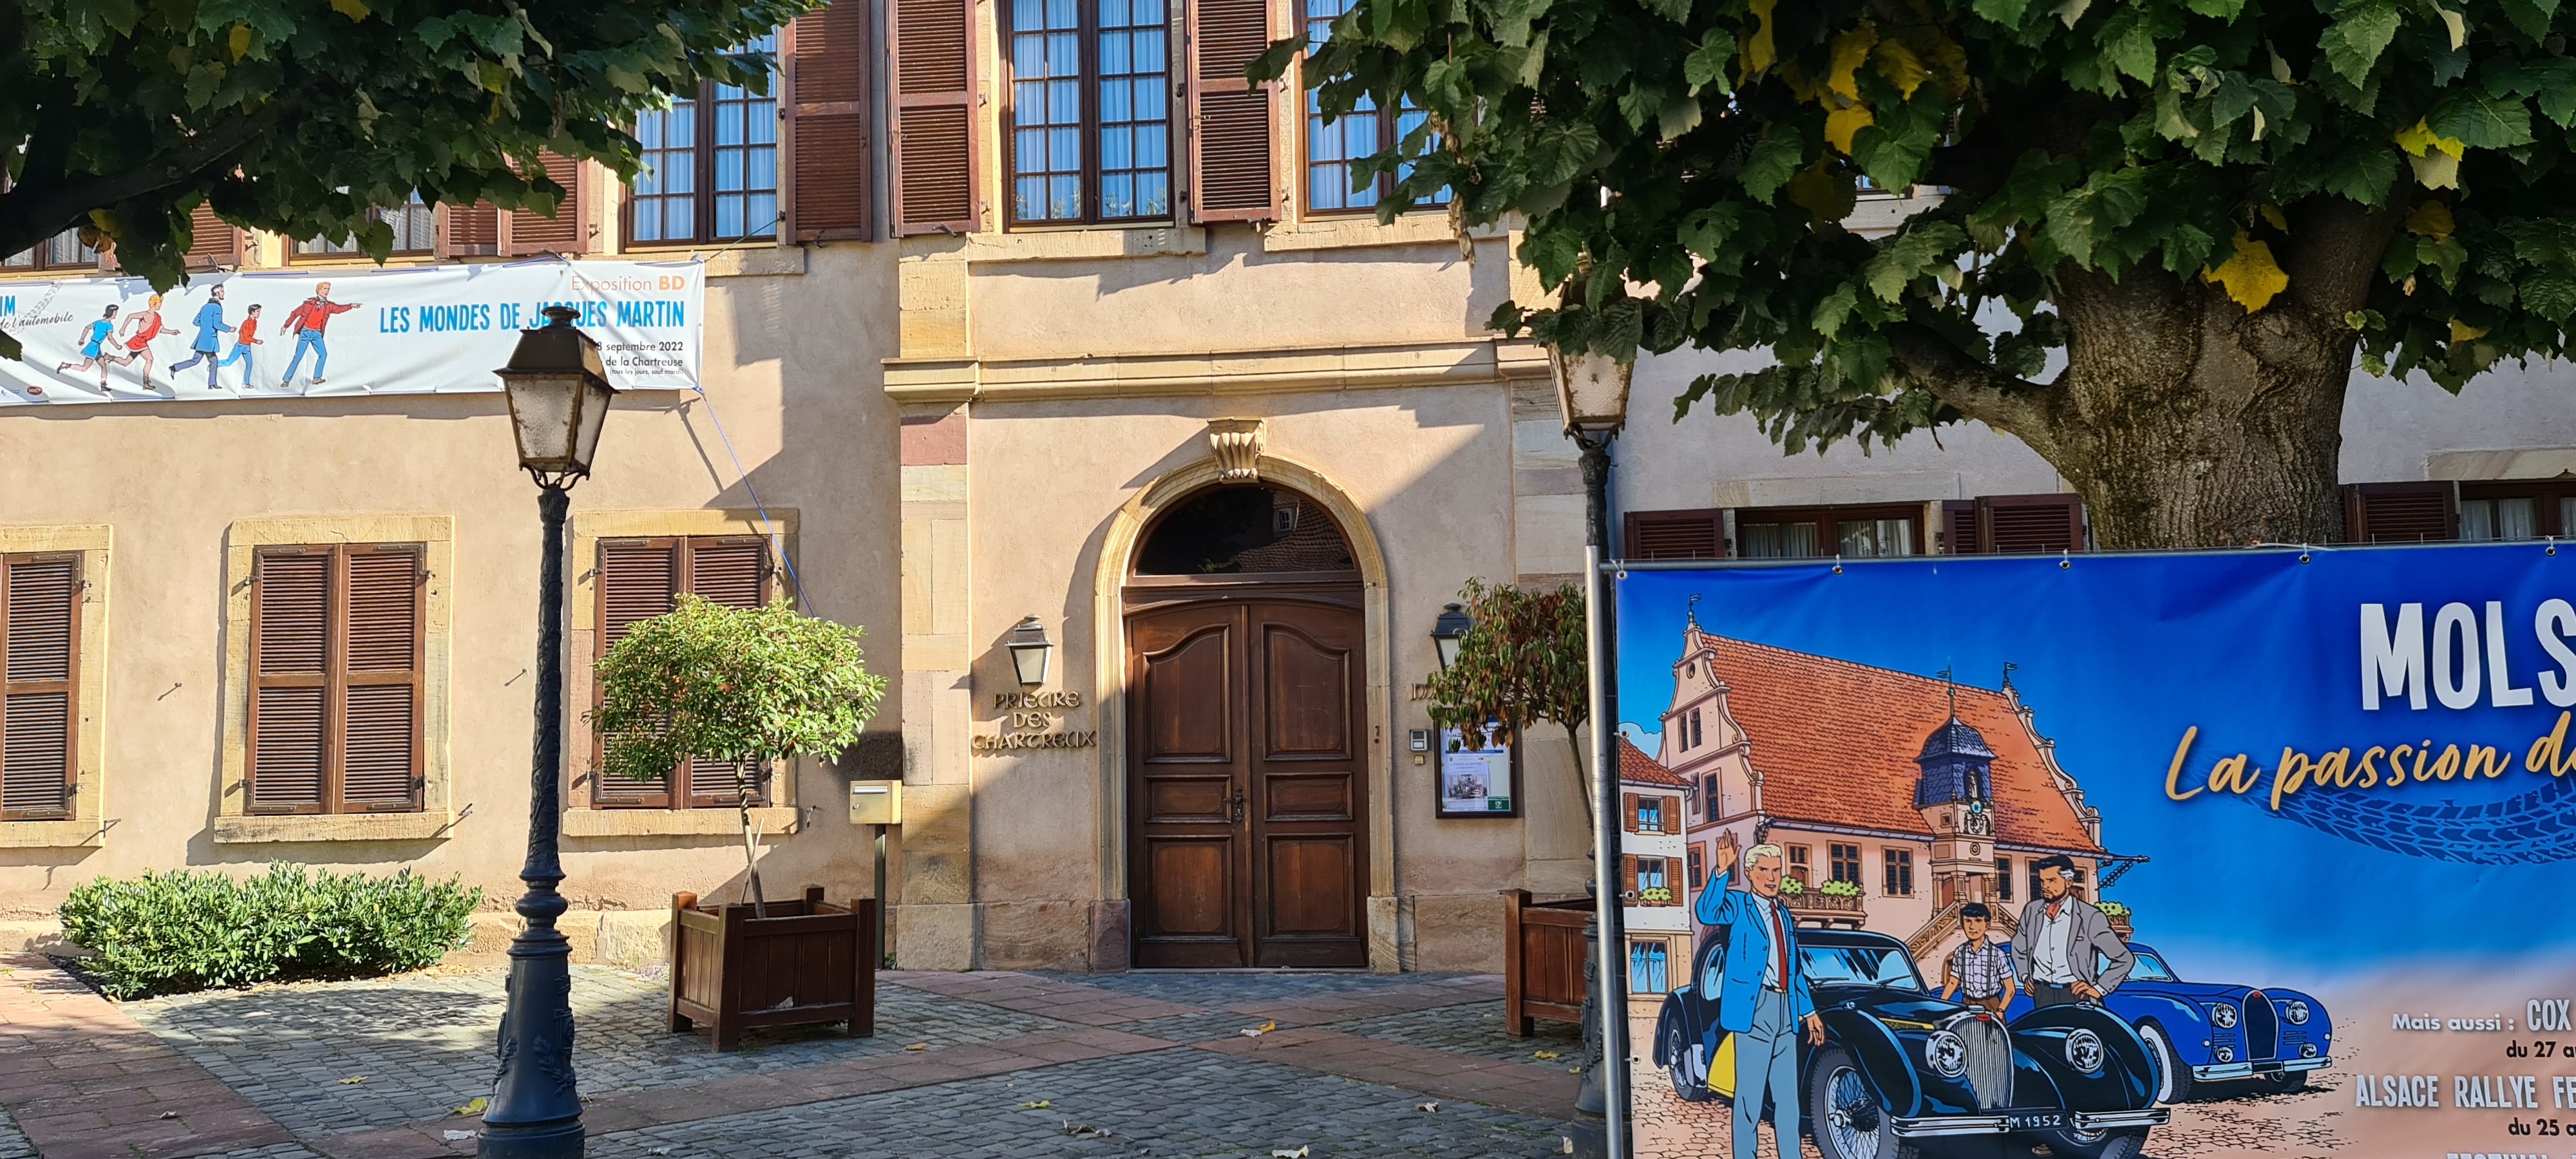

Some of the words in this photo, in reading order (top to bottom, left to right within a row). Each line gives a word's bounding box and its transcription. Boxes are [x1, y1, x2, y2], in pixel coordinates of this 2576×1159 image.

[572, 276, 652, 294] Exposition
[659, 276, 685, 290] BD
[12, 311, 73, 328] l'automobile
[380, 307, 410, 333] LES
[419, 304, 489, 332] MONDES
[500, 303, 520, 330] DE
[529, 301, 607, 328] JAUES
[616, 301, 684, 327] MARTIN
[606, 341, 656, 353] septembre
[659, 341, 683, 351] 2022
[606, 356, 616, 366] de
[621, 356, 629, 366] la
[632, 356, 683, 366] Chartreuse
[2360, 599, 2576, 710] MOLS
[993, 690, 1079, 708] PRIEURE
[1013, 711, 1052, 728] DES
[971, 730, 1096, 749] CHARTREUX
[2164, 726, 2260, 800] La
[2270, 740, 2510, 810] passion
[2525, 710, 2576, 777] d
[2392, 1013, 2441, 1030] Mais
[2447, 1013, 2501, 1030] aussi
[2527, 999, 2572, 1031] COX
[2506, 1039, 2528, 1058] du
[2533, 1041, 2557, 1058] 27
[2562, 1046, 2576, 1058] a
[2355, 1075, 2439, 1107] ALSACE
[2454, 1075, 2539, 1108] RALLYE
[2009, 1117, 2020, 1128] M
[2025, 1115, 2061, 1127] 1952
[2508, 1117, 2531, 1136] du
[2536, 1118, 2560, 1136] 25
